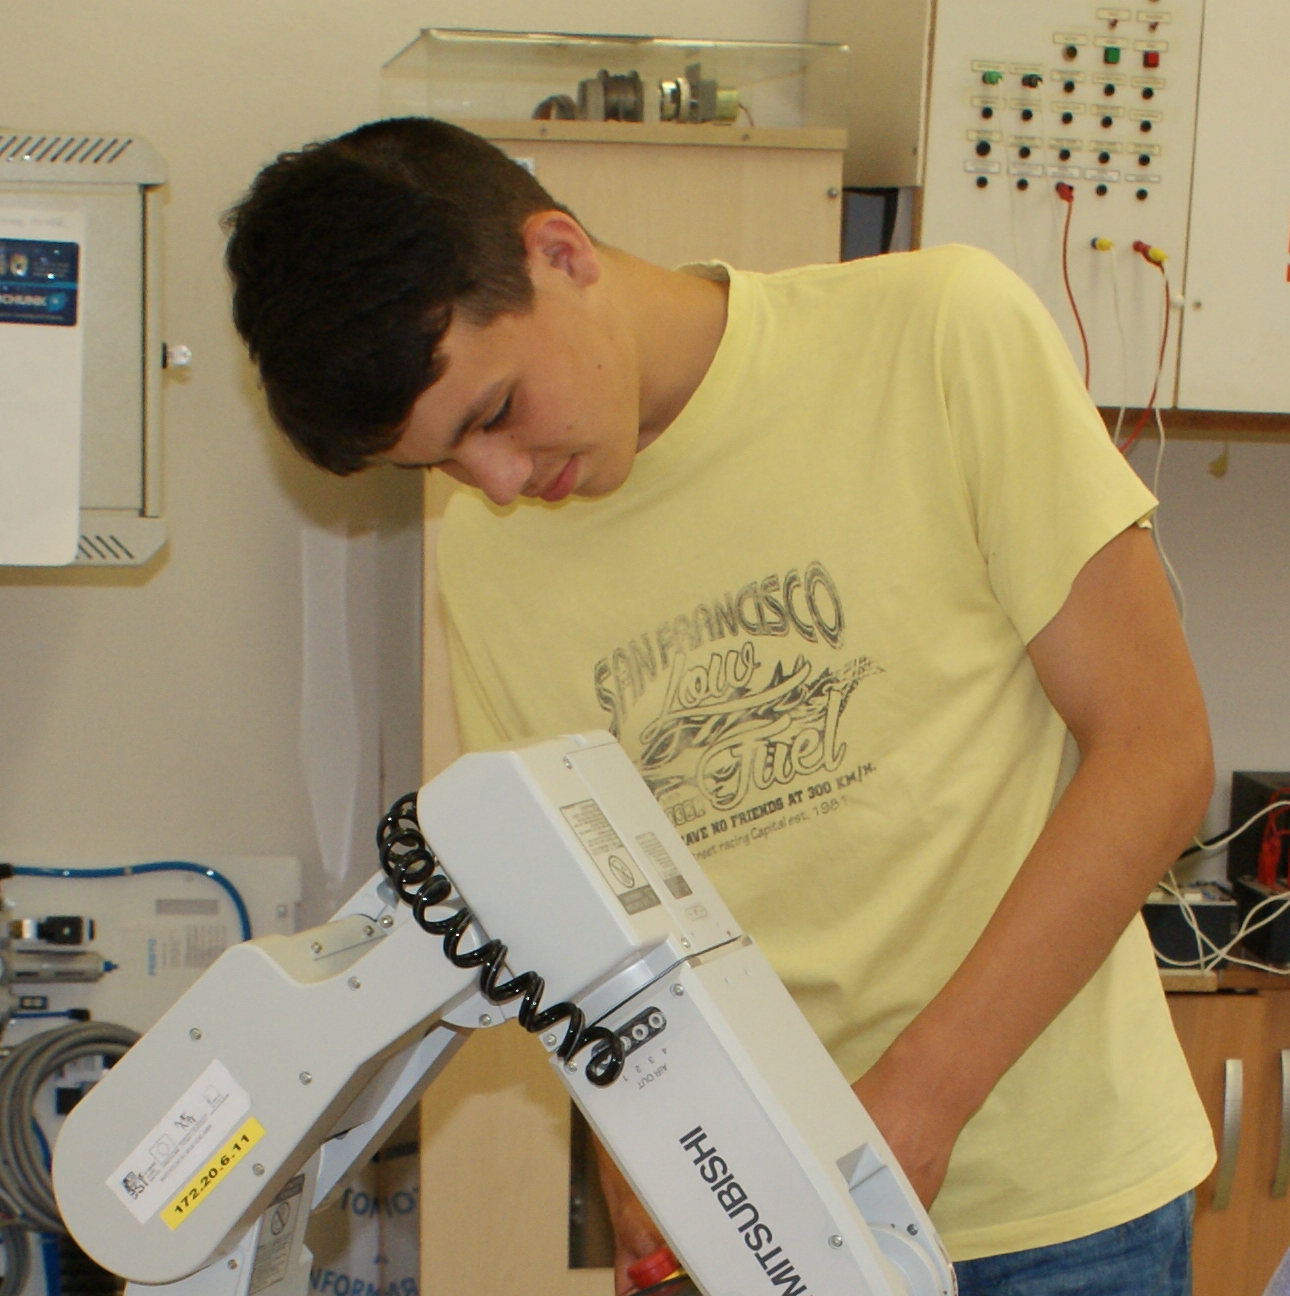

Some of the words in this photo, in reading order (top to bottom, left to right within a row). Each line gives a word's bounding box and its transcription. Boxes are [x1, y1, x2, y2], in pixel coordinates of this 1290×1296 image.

[710, 818, 728, 835] NO
[730, 796, 784, 828] FRIENDS
[787, 789, 804, 806] AT
[807, 782, 833, 800] 300
[174, 1133, 250, 1214] 172.20.6.11
